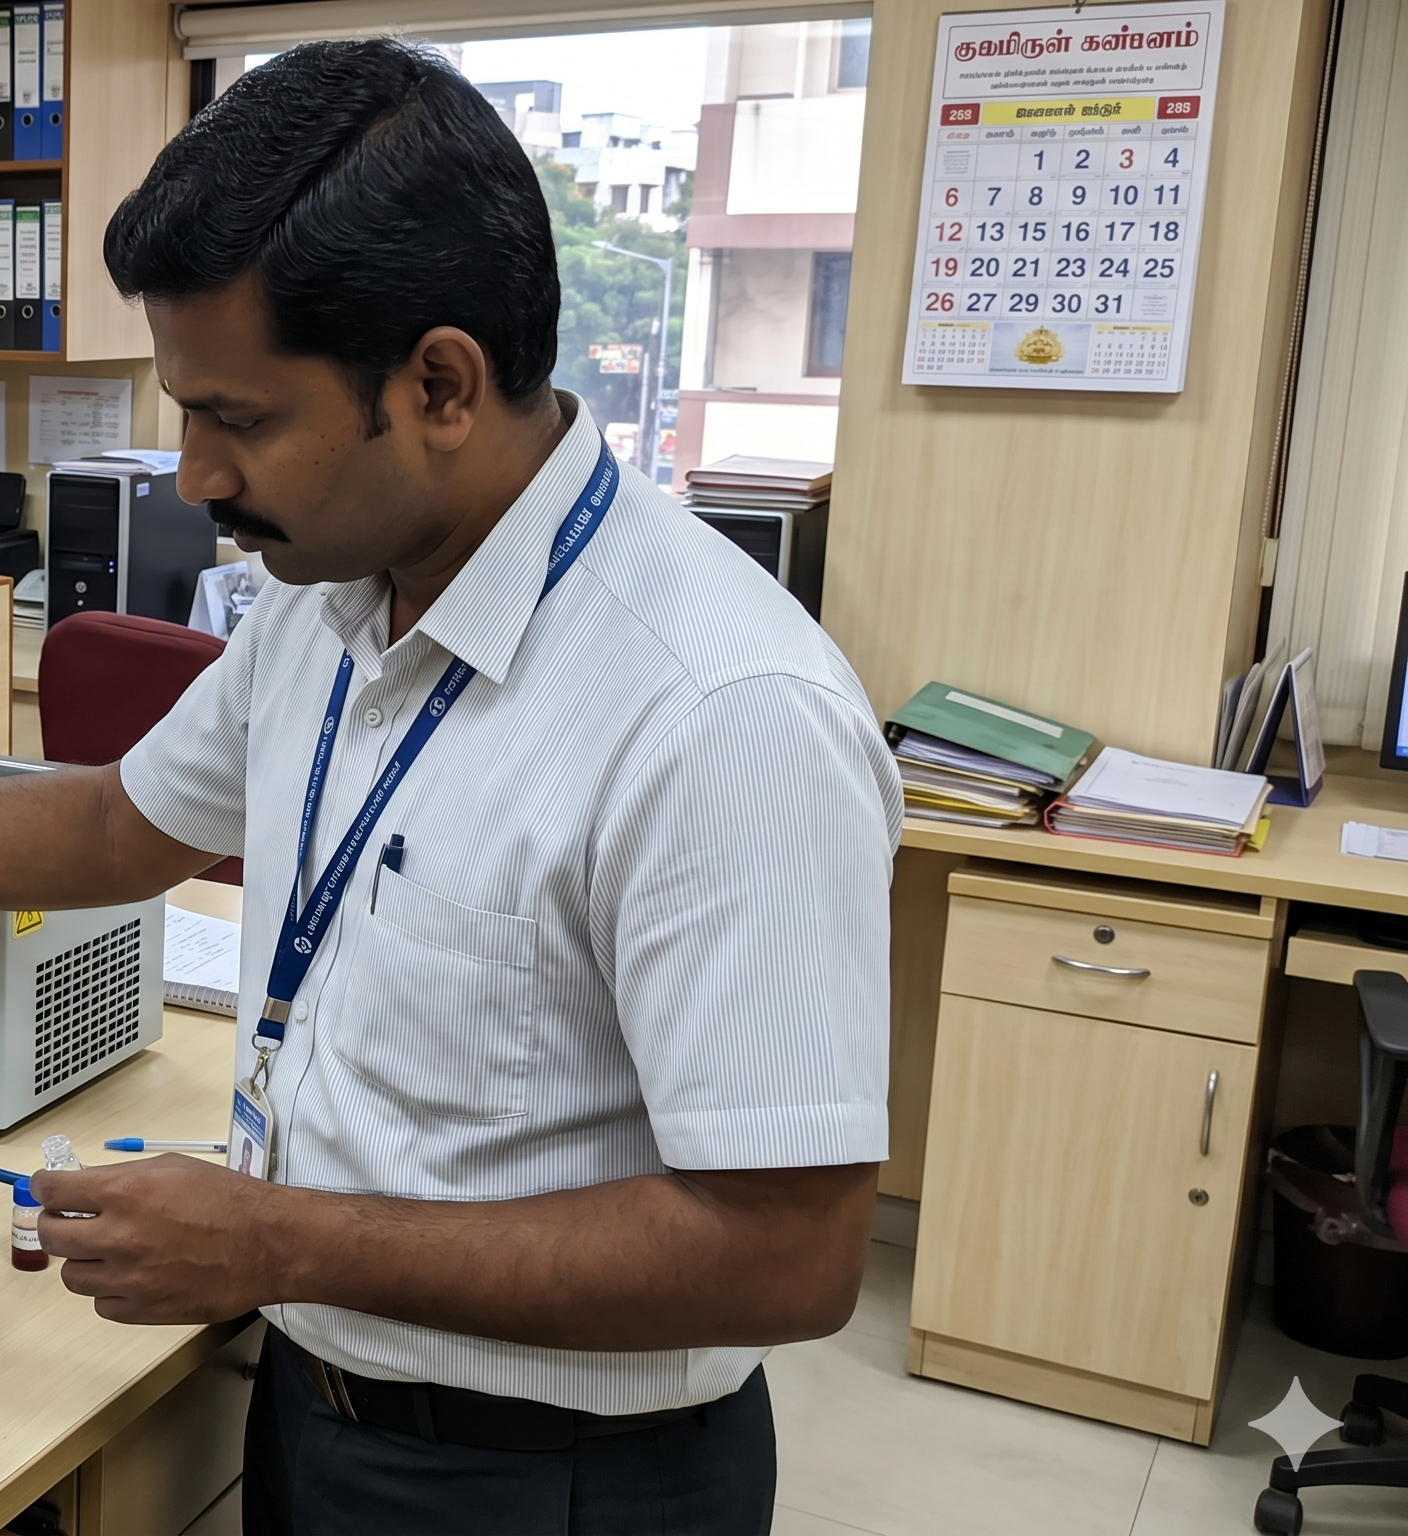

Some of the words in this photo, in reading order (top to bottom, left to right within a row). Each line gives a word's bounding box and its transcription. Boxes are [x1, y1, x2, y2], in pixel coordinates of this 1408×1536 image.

[1033, 150, 1044, 171] 1
[1074, 149, 1090, 169] 2
[1119, 148, 1134, 169] 3
[1163, 147, 1180, 168] 4
[945, 187, 959, 207] 6
[987, 187, 1002, 206] 7
[1028, 186, 1043, 206] 8
[1072, 185, 1087, 206] 9
[1109, 184, 1139, 206] 10
[1154, 184, 1180, 205] 11
[935, 222, 963, 242] 12
[976, 221, 1005, 242] 13
[1018, 221, 1047, 242] 15
[1061, 221, 1090, 242] 16
[1104, 221, 1136, 242] 17
[1149, 221, 1179, 242] 18
[931, 257, 958, 277] 19
[969, 257, 1000, 278] 20
[1011, 257, 1040, 278] 21
[1055, 257, 1086, 278] 23
[1098, 257, 1130, 278] 24
[1142, 258, 1175, 279] 25
[925, 292, 954, 312] 26
[966, 292, 998, 312] 27
[1008, 293, 1039, 313] 29
[1051, 293, 1082, 314] 30
[1094, 294, 1123, 314] 31
